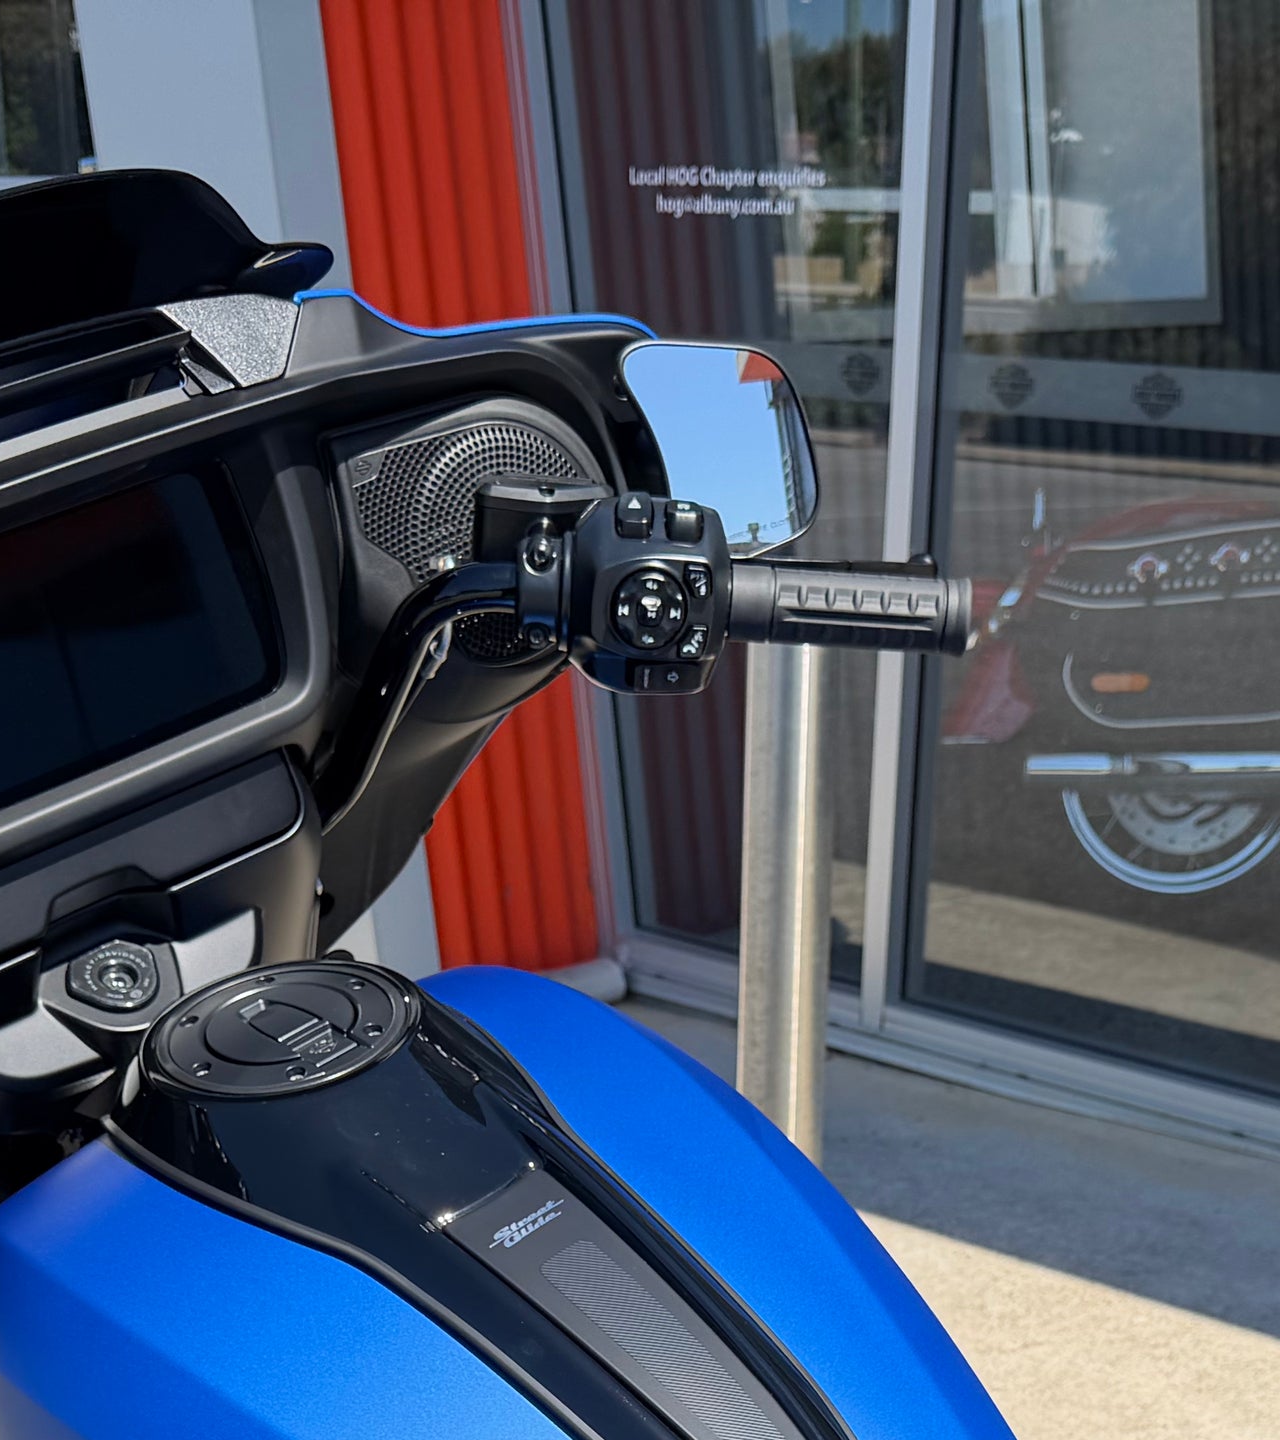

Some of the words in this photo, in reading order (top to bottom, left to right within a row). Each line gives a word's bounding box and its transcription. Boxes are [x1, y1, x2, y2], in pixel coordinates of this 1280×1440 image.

[628, 165, 665, 186] Local
[666, 165, 699, 186] HOG
[700, 165, 756, 191] Chapter
[757, 166, 826, 190] enquiries
[490, 1199, 564, 1247] Street
